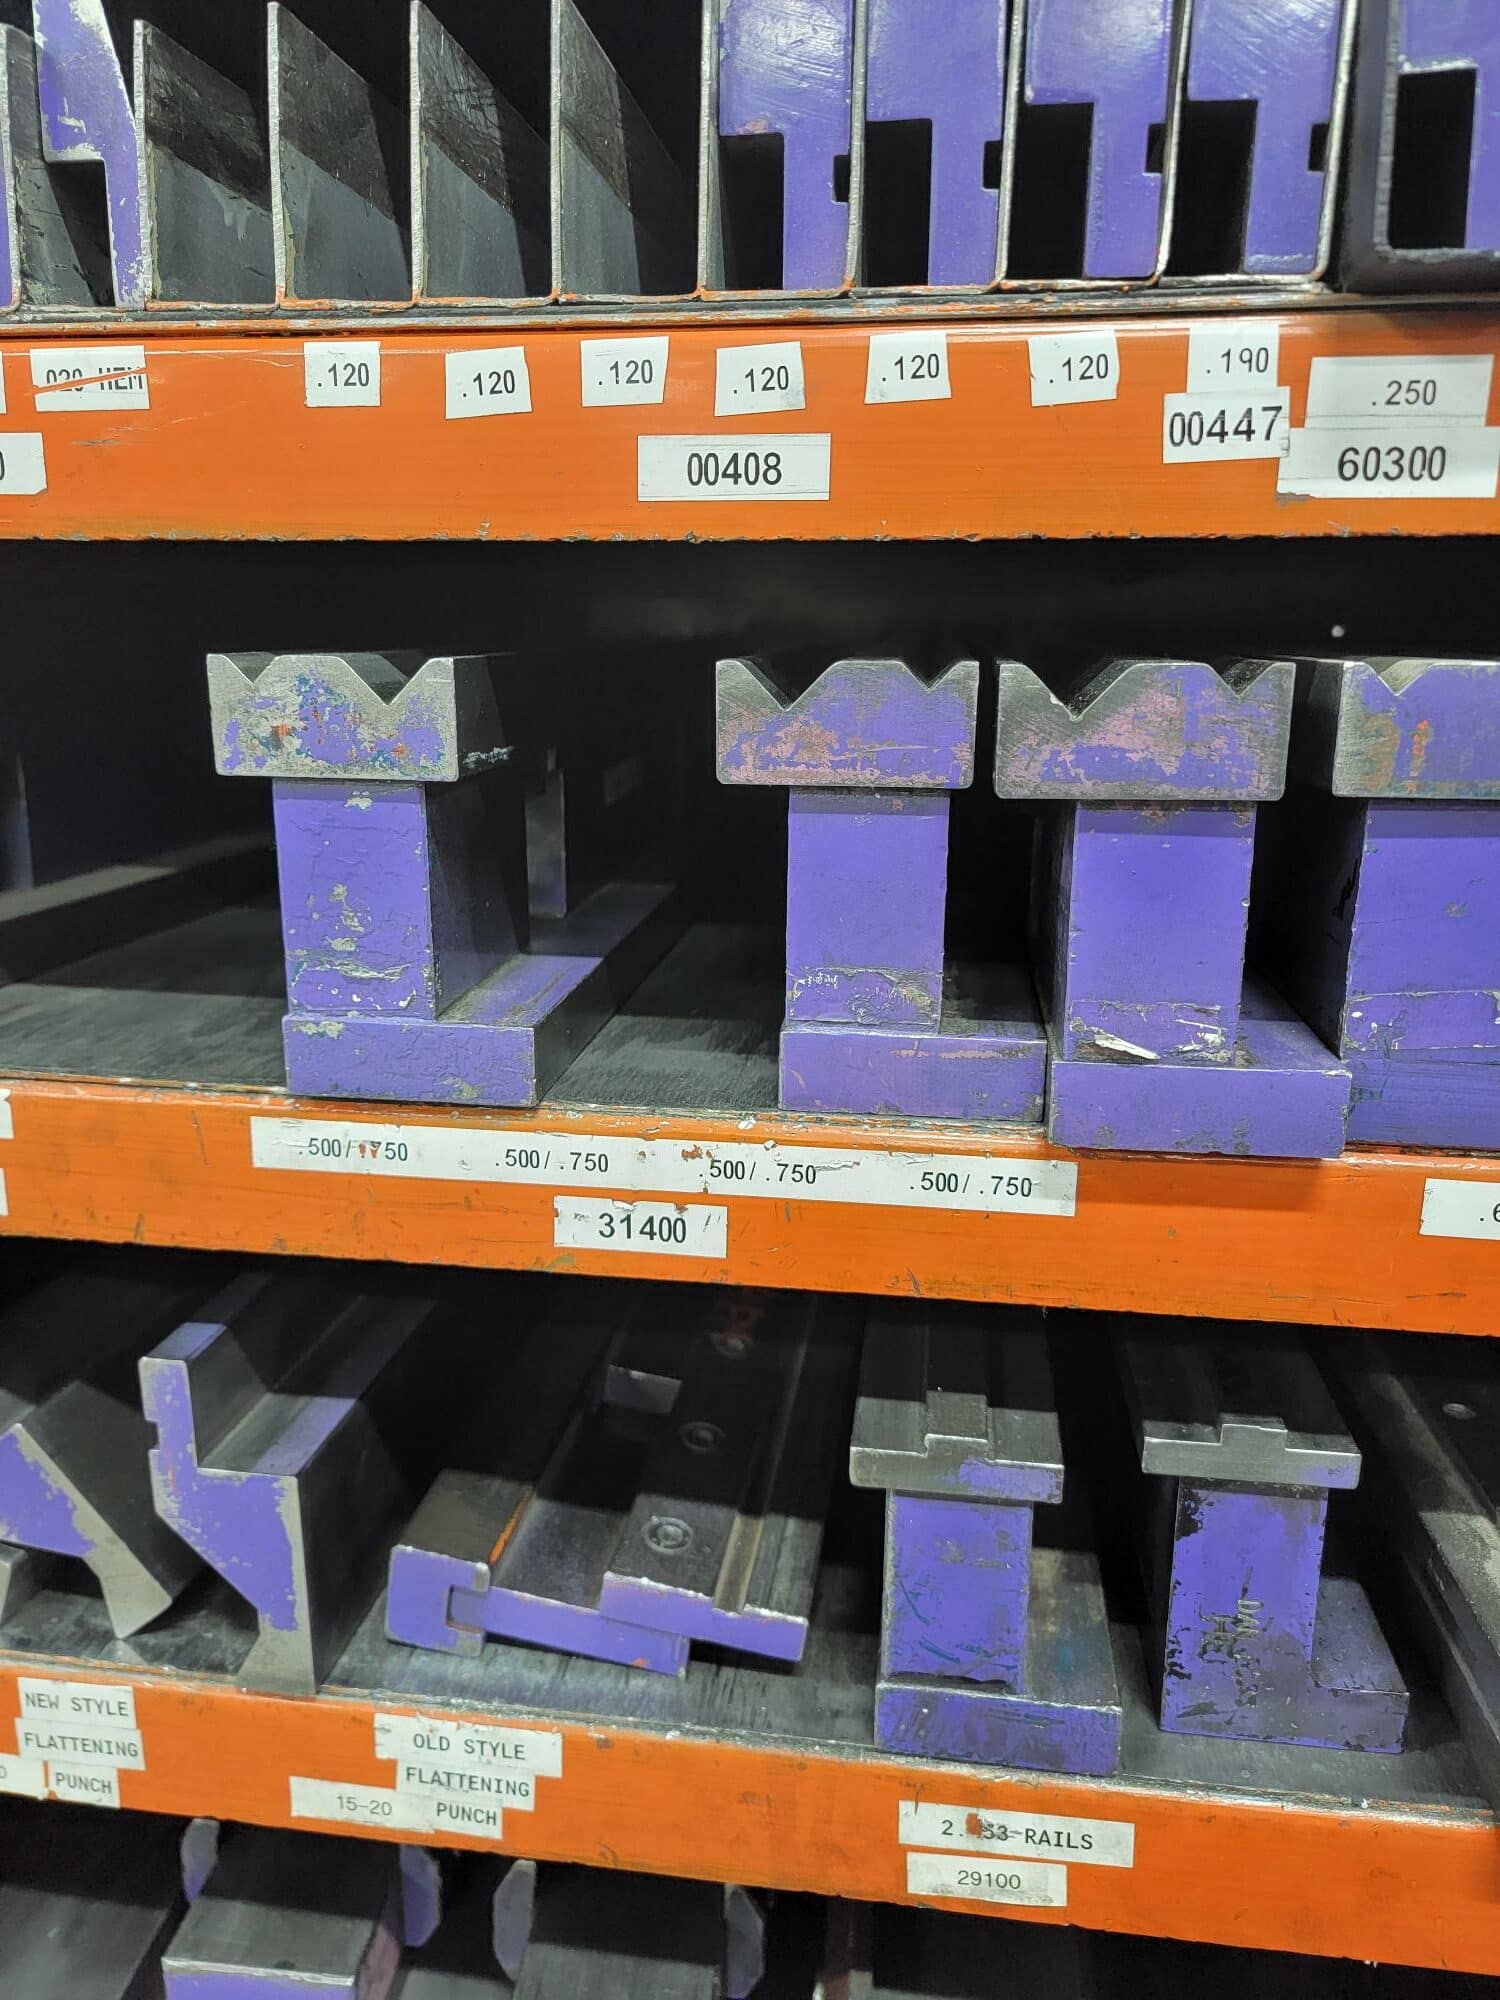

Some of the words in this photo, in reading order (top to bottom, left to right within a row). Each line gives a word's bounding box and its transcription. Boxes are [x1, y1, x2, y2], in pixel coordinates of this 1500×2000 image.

[599, 360, 653, 385] .120
[882, 354, 939, 381] .120
[1050, 354, 1108, 383] .120
[1207, 347, 1268, 373] .190
[318, 363, 369, 387] .120
[463, 370, 515, 397] .120
[734, 366, 788, 394] .120
[1372, 380, 1436, 406] .250
[1169, 406, 1282, 447] 00447
[688, 452, 782, 486] 00408
[1338, 446, 1446, 481] 60300
[599, 1210, 687, 1243] 31400
[25, 1693, 59, 1709] NEW
[71, 1697, 128, 1716] STYLE
[24, 1732, 138, 1757] FLATTENING
[413, 1734, 450, 1751] OLD
[465, 1739, 525, 1760] STYLE
[54, 1772, 112, 1796] PUNCH
[406, 1767, 529, 1797] FLATTENING
[336, 1795, 392, 1816] 15-20
[437, 1802, 496, 1826] PUNCH
[958, 1870, 1021, 1890] 29100
